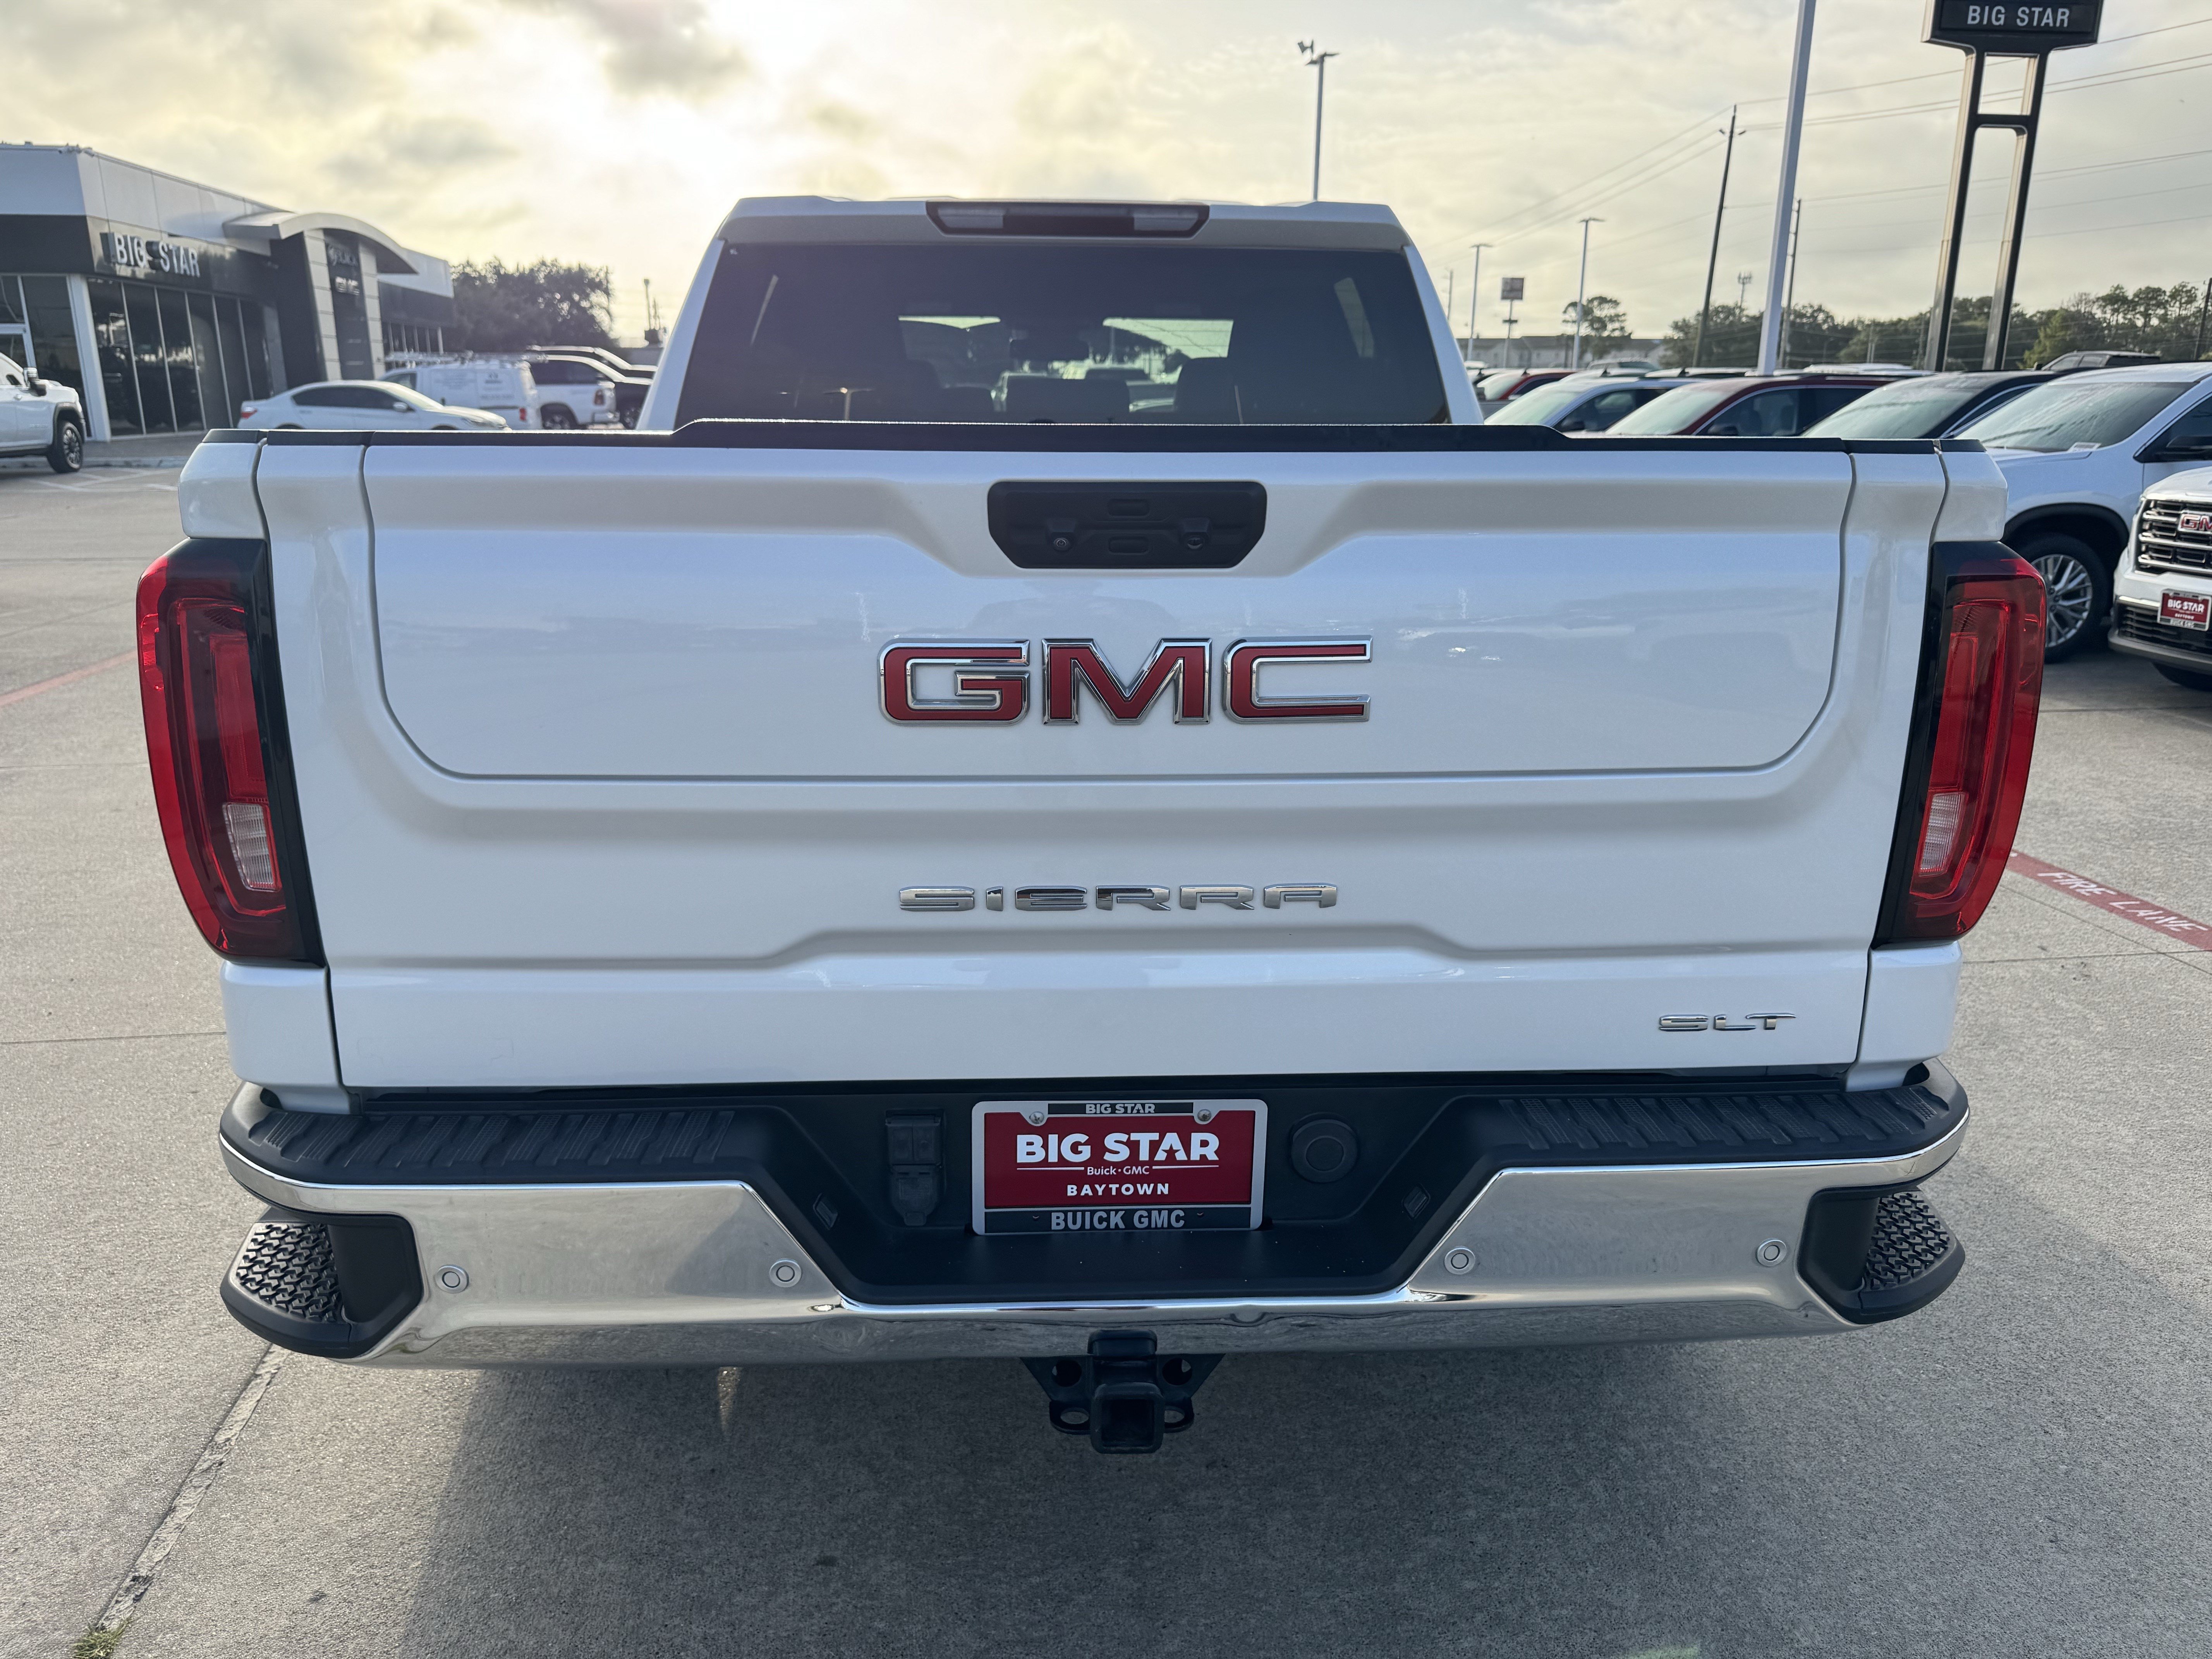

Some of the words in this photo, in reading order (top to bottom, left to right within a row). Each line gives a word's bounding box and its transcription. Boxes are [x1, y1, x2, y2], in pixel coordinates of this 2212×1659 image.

[1967, 5, 2005, 26] BIG
[2016, 7, 2069, 27] STAR
[114, 232, 146, 269] BIG
[159, 241, 201, 278] STAR
[2180, 514, 2212, 531] GM
[2167, 599, 2182, 609] BIG
[2183, 601, 2205, 613] STAR
[877, 635, 1373, 725] GMC
[899, 884, 1338, 911] SIERRA
[2037, 871, 2118, 896] FIRE
[2109, 901, 2208, 932] LANE
[1659, 1012, 1797, 1032] SLT
[1085, 1103, 1111, 1114] BIG
[1115, 1103, 1155, 1114] STAR
[1017, 1133, 1091, 1163] BIG
[1103, 1132, 1219, 1162] STAR
[1087, 1166, 1117, 1176] Buick
[1123, 1166, 1150, 1175] GMC
[1066, 1183, 1169, 1197] BAYTOWN
[1051, 1210, 1125, 1230] BUICK
[1133, 1209, 1185, 1229] GMC
